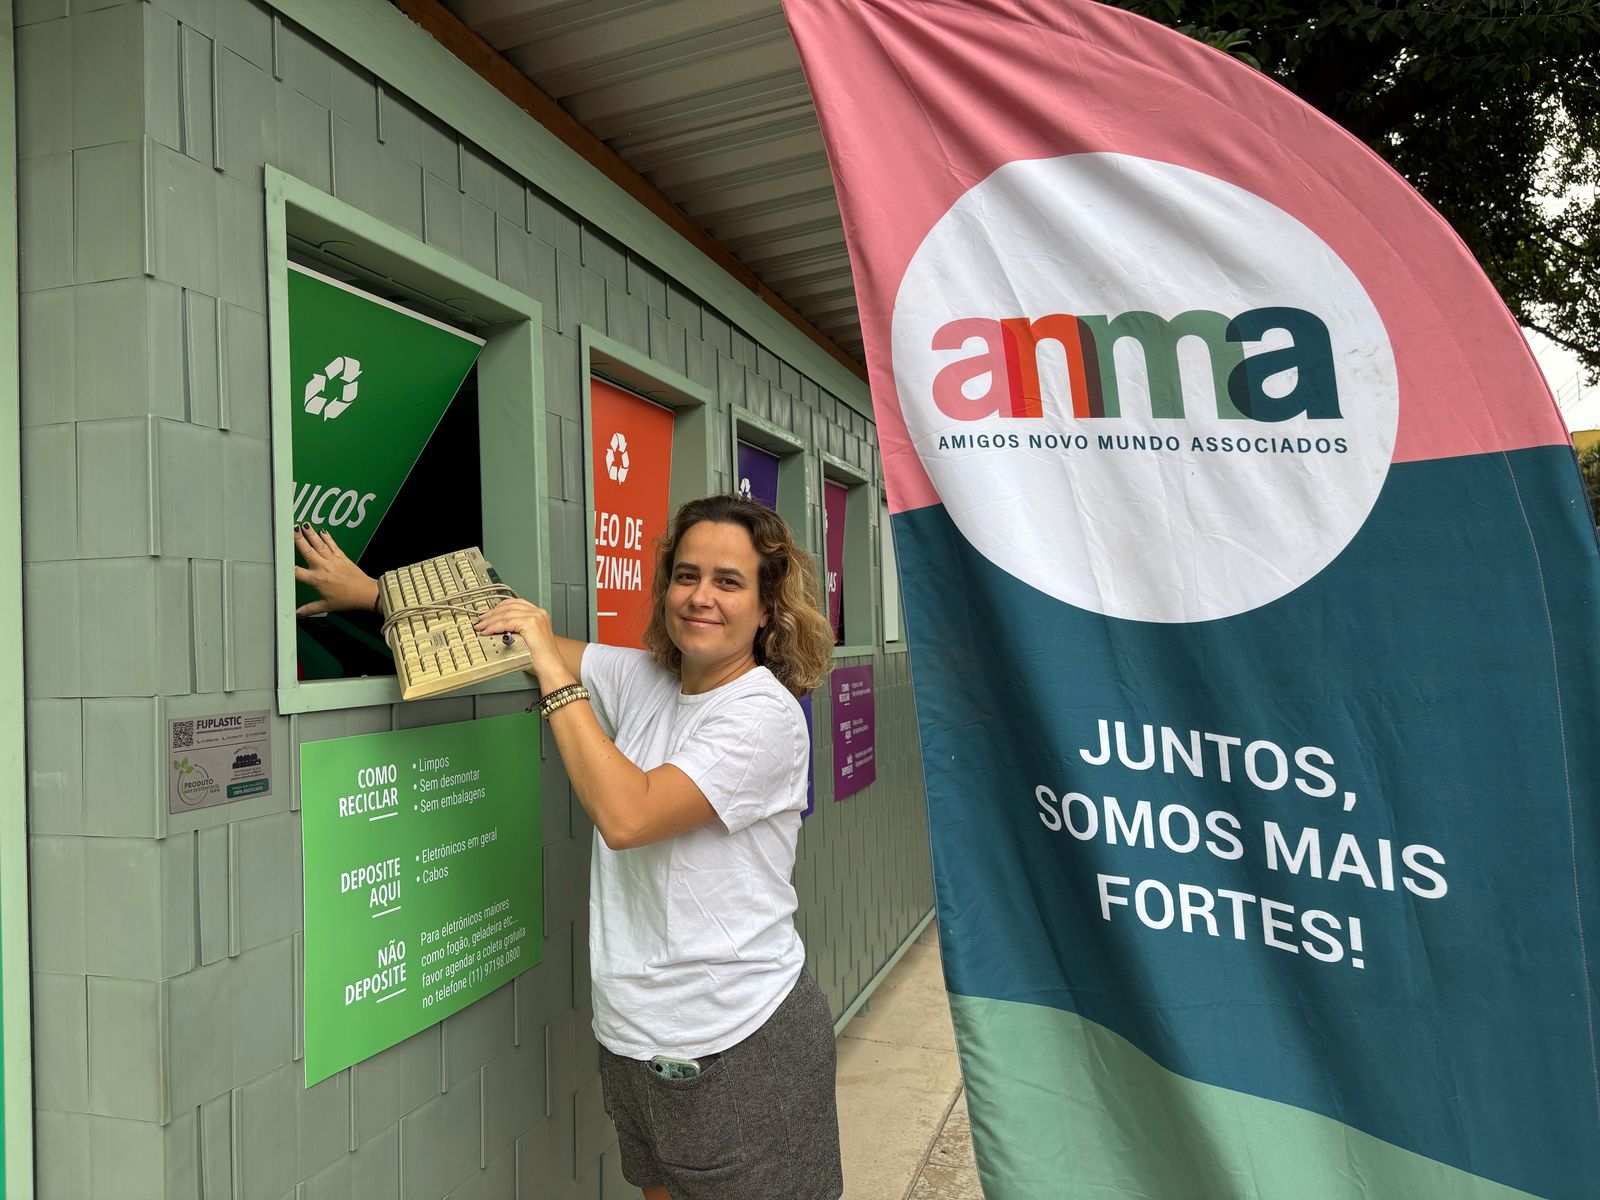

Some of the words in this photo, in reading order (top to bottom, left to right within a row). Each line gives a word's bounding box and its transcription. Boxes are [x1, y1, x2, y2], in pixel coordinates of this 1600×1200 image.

[931, 306, 1344, 423] anma
[938, 434, 1020, 450] AMIGOS
[1029, 434, 1089, 450] NOVO
[1098, 434, 1181, 453] MUNDO
[1190, 435, 1348, 454] ASSOCIADOS
[624, 516, 643, 551] DE
[596, 555, 642, 591] ZINHA
[196, 716, 242, 730] FUPLASTIC
[357, 764, 397, 789] COMO
[419, 756, 450, 772] Limpos
[419, 778, 439, 793] Sem
[440, 769, 480, 788] desmontar
[1079, 719, 1357, 812] JUNTOS,
[184, 778, 214, 789] PRODUTO
[420, 798, 439, 813] Sem
[440, 787, 486, 808] embalagens
[338, 787, 399, 818] RECICLAR
[422, 840, 466, 864] Eletrônicos
[467, 836, 479, 849] em
[480, 826, 498, 848] geral
[1035, 784, 1244, 861] SOMOS
[1263, 820, 1449, 900] MAIS
[341, 857, 401, 893] DEPOSITE
[422, 866, 449, 884] Cabos
[369, 879, 401, 908] AQUI
[420, 931, 440, 946] Para
[441, 910, 482, 937] eletrônicos
[483, 898, 510, 919] maiores
[1096, 873, 1365, 970] FORTES!
[377, 938, 406, 969] NÃO
[421, 948, 445, 967] como
[446, 936, 470, 955] fogão,
[472, 920, 502, 947] geladeira
[422, 968, 444, 989] favor
[445, 953, 475, 978] agendar
[476, 950, 481, 961] a
[482, 939, 503, 958] coleta
[503, 926, 526, 950] gratuita
[345, 962, 407, 1006] DEPOSITE
[422, 994, 433, 1009] no
[435, 977, 467, 1002] telefone
[468, 965, 483, 988] (11)
[484, 945, 521, 976] 97198.0800
